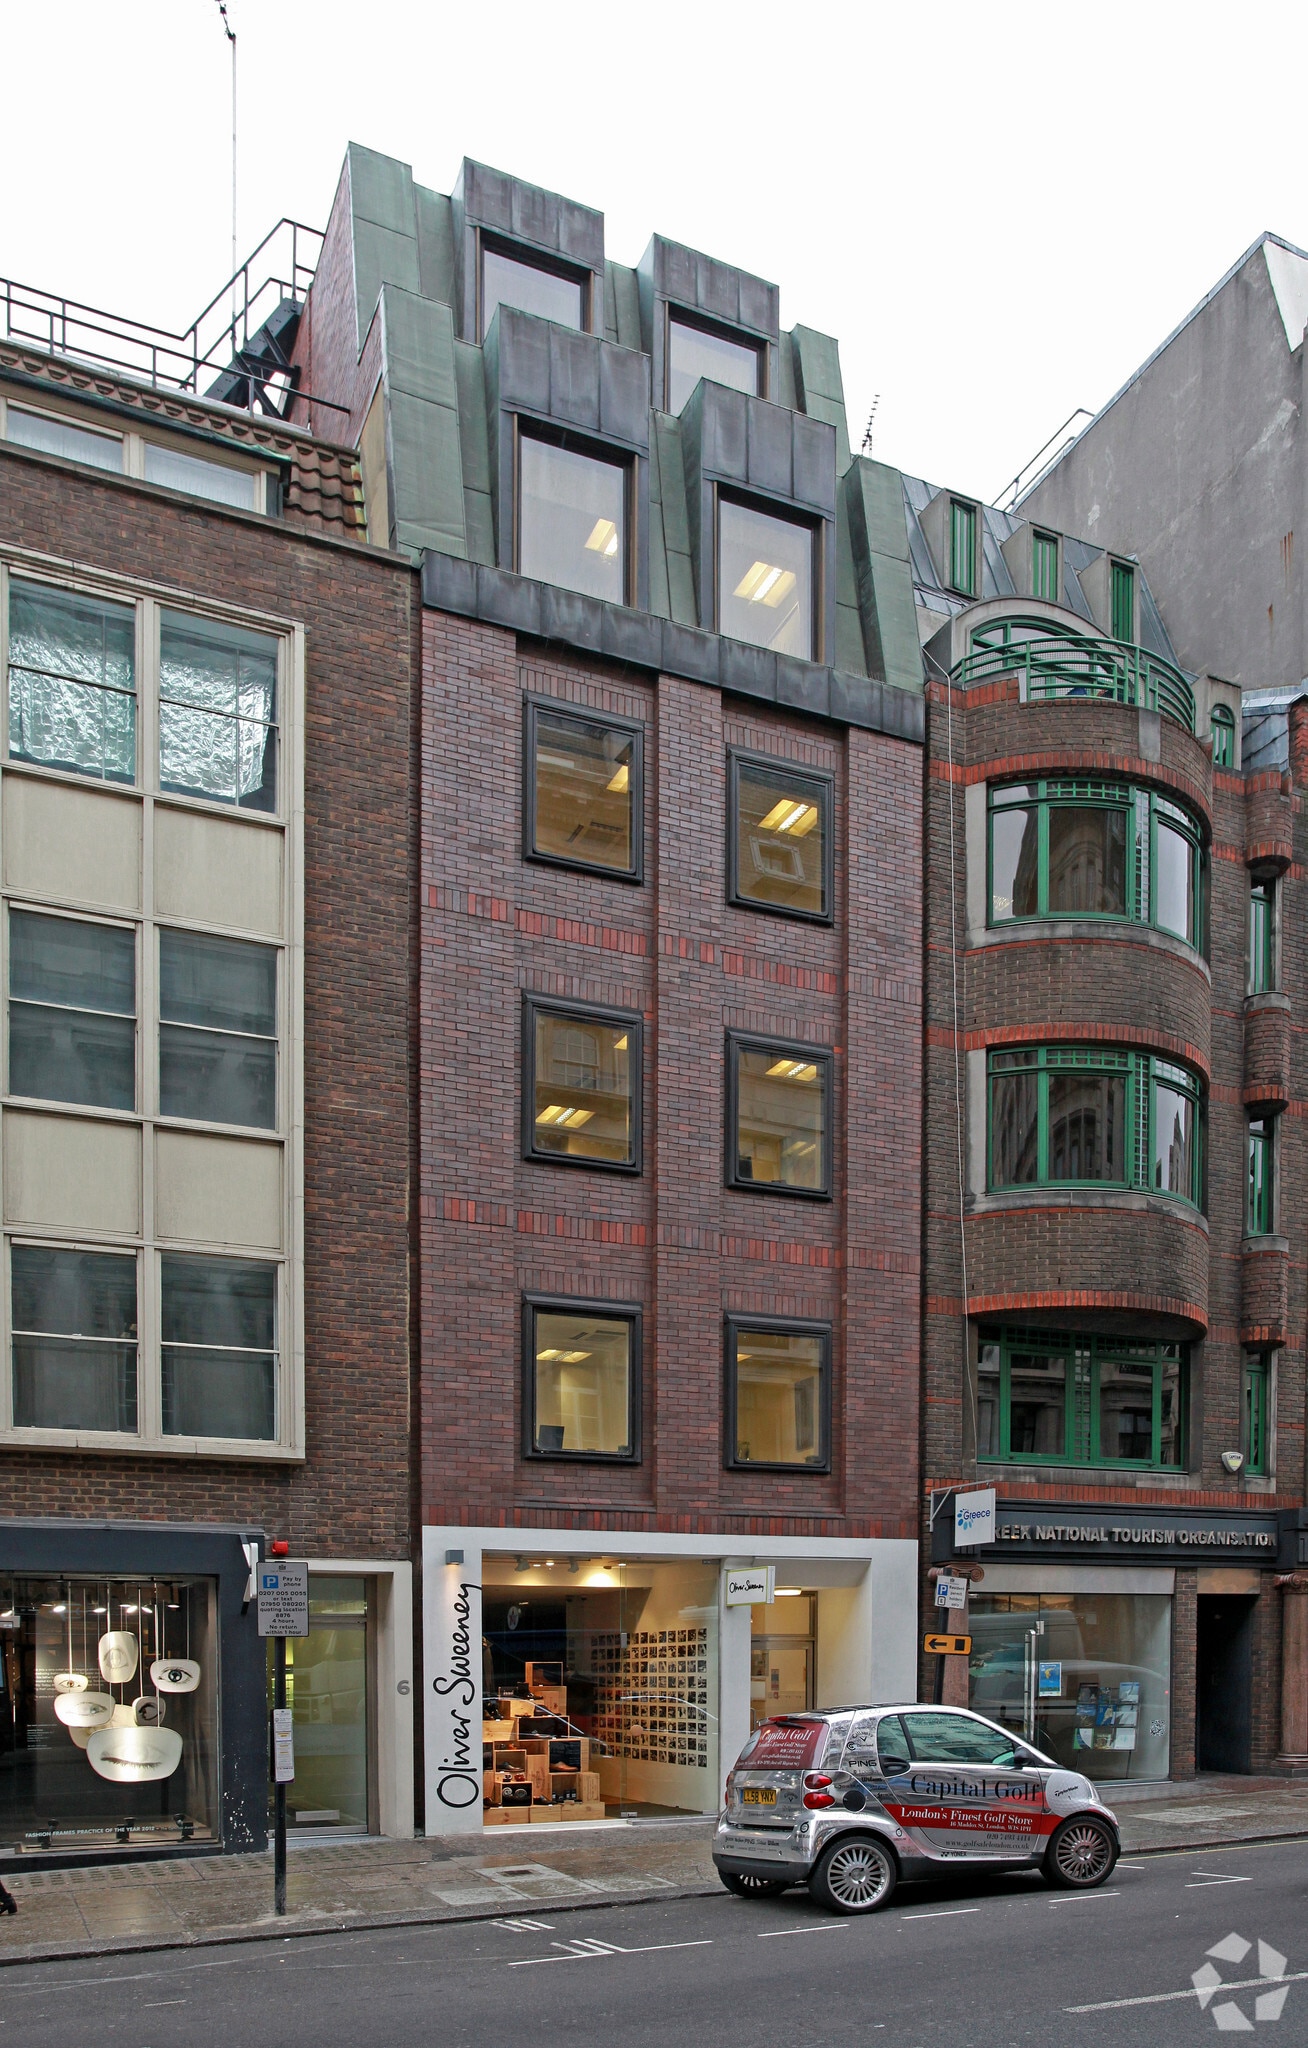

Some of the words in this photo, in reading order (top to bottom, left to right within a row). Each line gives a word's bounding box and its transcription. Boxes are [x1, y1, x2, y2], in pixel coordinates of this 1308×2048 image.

[964, 1510, 990, 1520] Greece
[995, 1525, 1032, 1540] REEK
[1036, 1526, 1108, 1542] NATIONAL
[1112, 1528, 1174, 1544] TOURISM
[1178, 1530, 1277, 1546] ORGANISATION
[729, 1582, 745, 1594] Oliver
[745, 1580, 764, 1592] Sweeney
[433, 1583, 482, 1706] Sweeney
[397, 1680, 410, 1695] 6
[761, 1730, 789, 1742] Capital
[790, 1729, 815, 1740] Golf
[436, 1709, 479, 1808] Oliver
[911, 1774, 986, 1800] Capital
[994, 1780, 1040, 1801] Golf
[744, 1791, 759, 1802] LL58
[761, 1791, 774, 1802] YNX
[901, 1807, 947, 1819] London's
[950, 1810, 981, 1822] Finest
[984, 1812, 1006, 1823] Golf
[1008, 1815, 1033, 1825] Store
[945, 1840, 1030, 1850] www.golfsalelondon.co.uk
